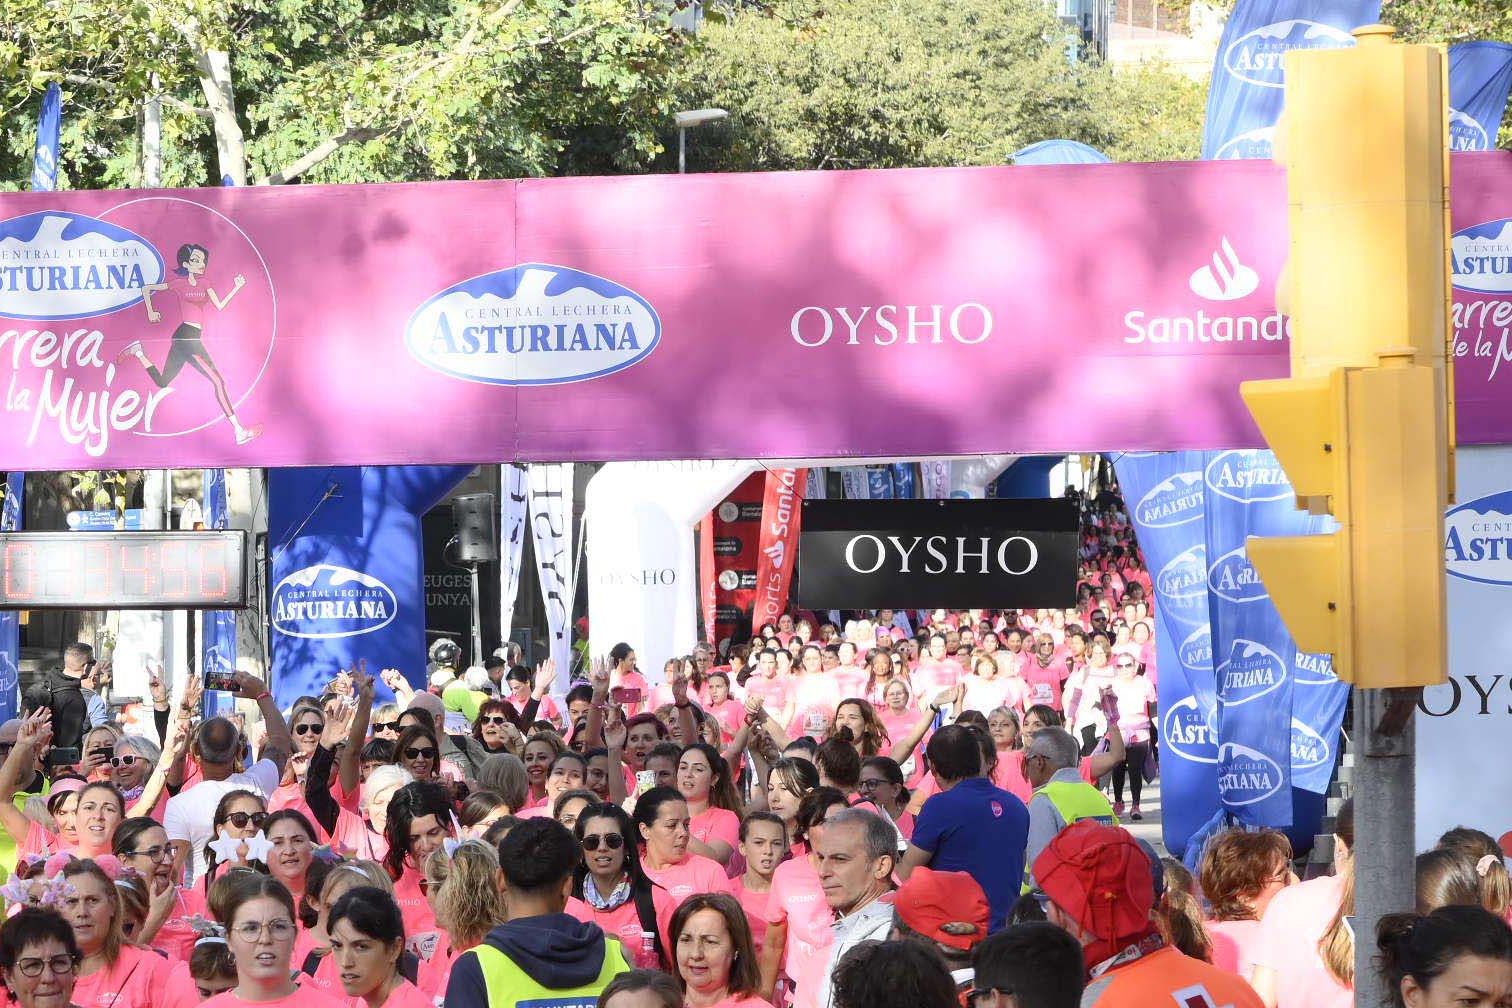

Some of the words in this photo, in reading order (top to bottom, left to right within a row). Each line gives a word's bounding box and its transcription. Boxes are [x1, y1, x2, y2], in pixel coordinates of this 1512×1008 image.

[68, 246, 140, 258] LECHERA
[465, 306, 543, 319] CENTRAL
[552, 303, 633, 317] LECHERA
[790, 302, 993, 347] OYSHO
[428, 311, 641, 354] ASTURIANA
[1475, 330, 1492, 357] la
[6, 373, 31, 411] la
[25, 361, 175, 456] Mujer
[845, 534, 1039, 576] OYSHO
[275, 595, 388, 622] ASTURIANA
[288, 590, 330, 599] CENTRAL
